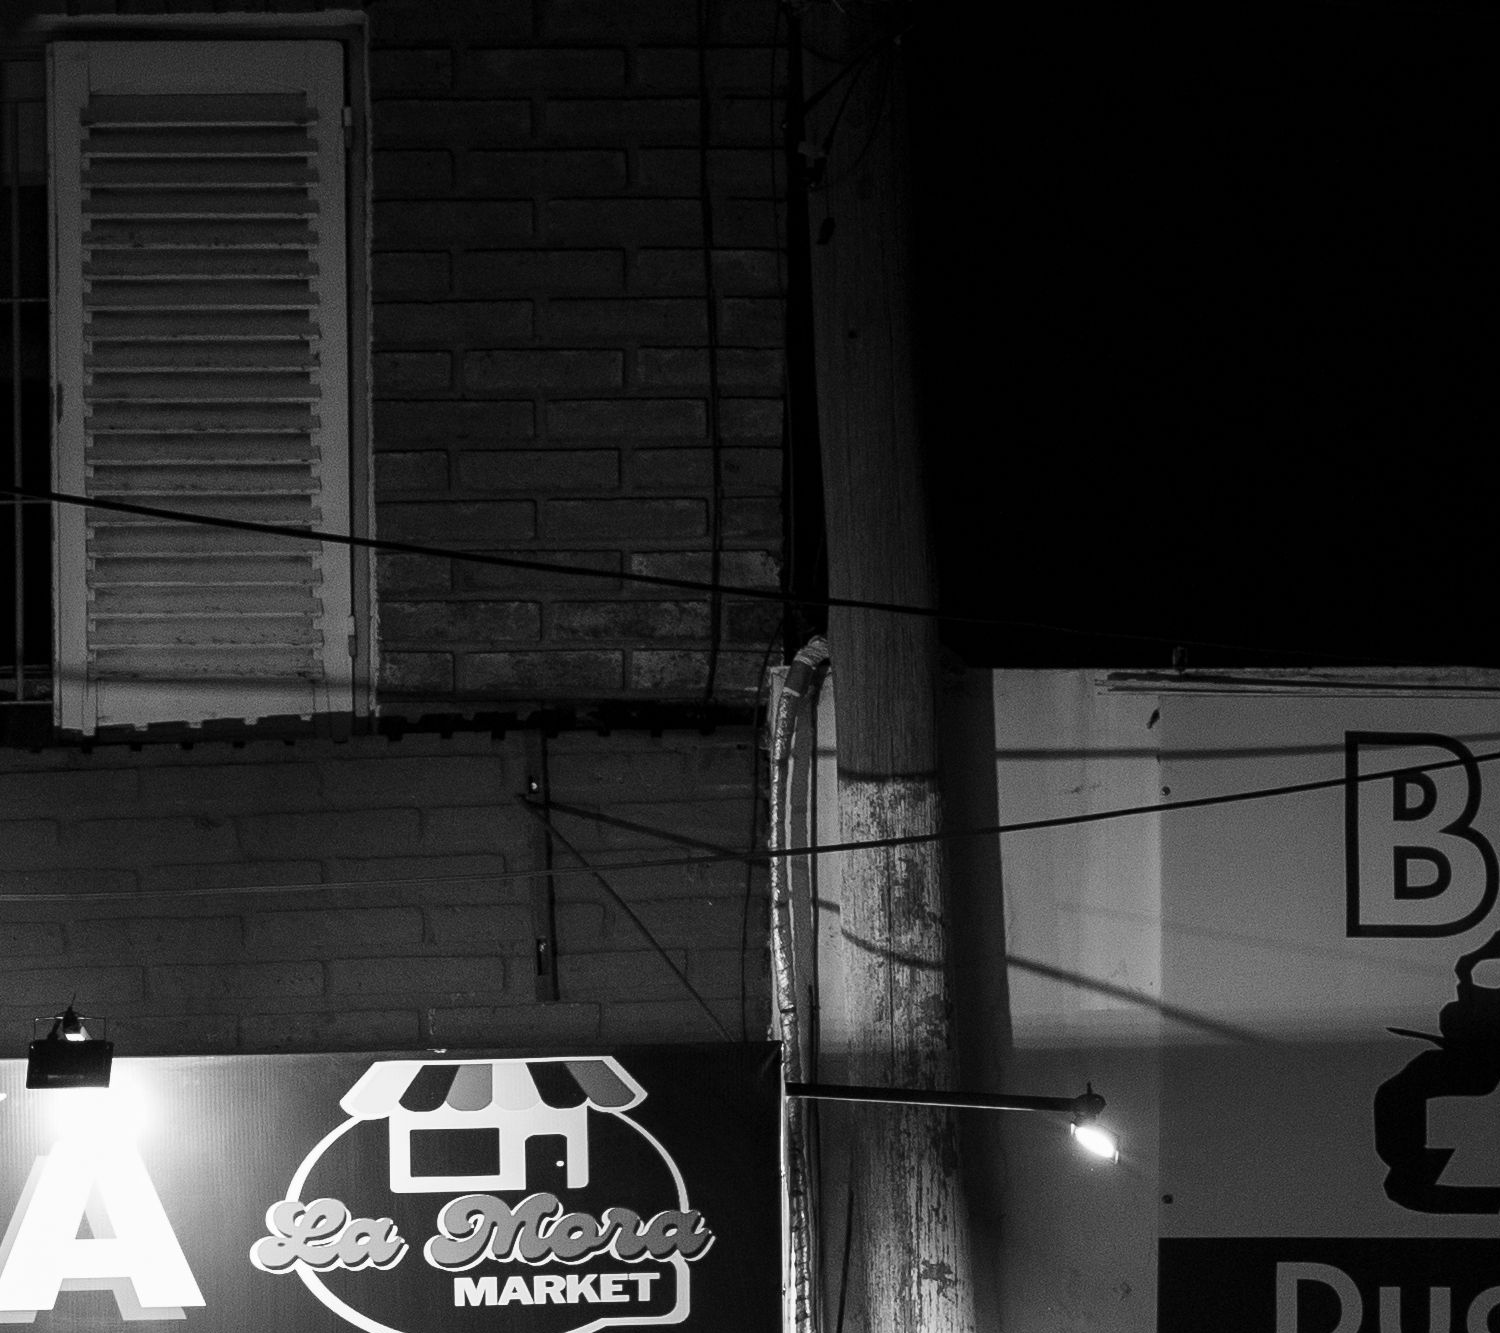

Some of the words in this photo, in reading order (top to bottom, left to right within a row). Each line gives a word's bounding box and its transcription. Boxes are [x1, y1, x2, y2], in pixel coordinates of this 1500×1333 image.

[250, 1198, 409, 1274] La
[424, 1192, 716, 1272] Mora
[454, 1273, 660, 1307] MARKET
